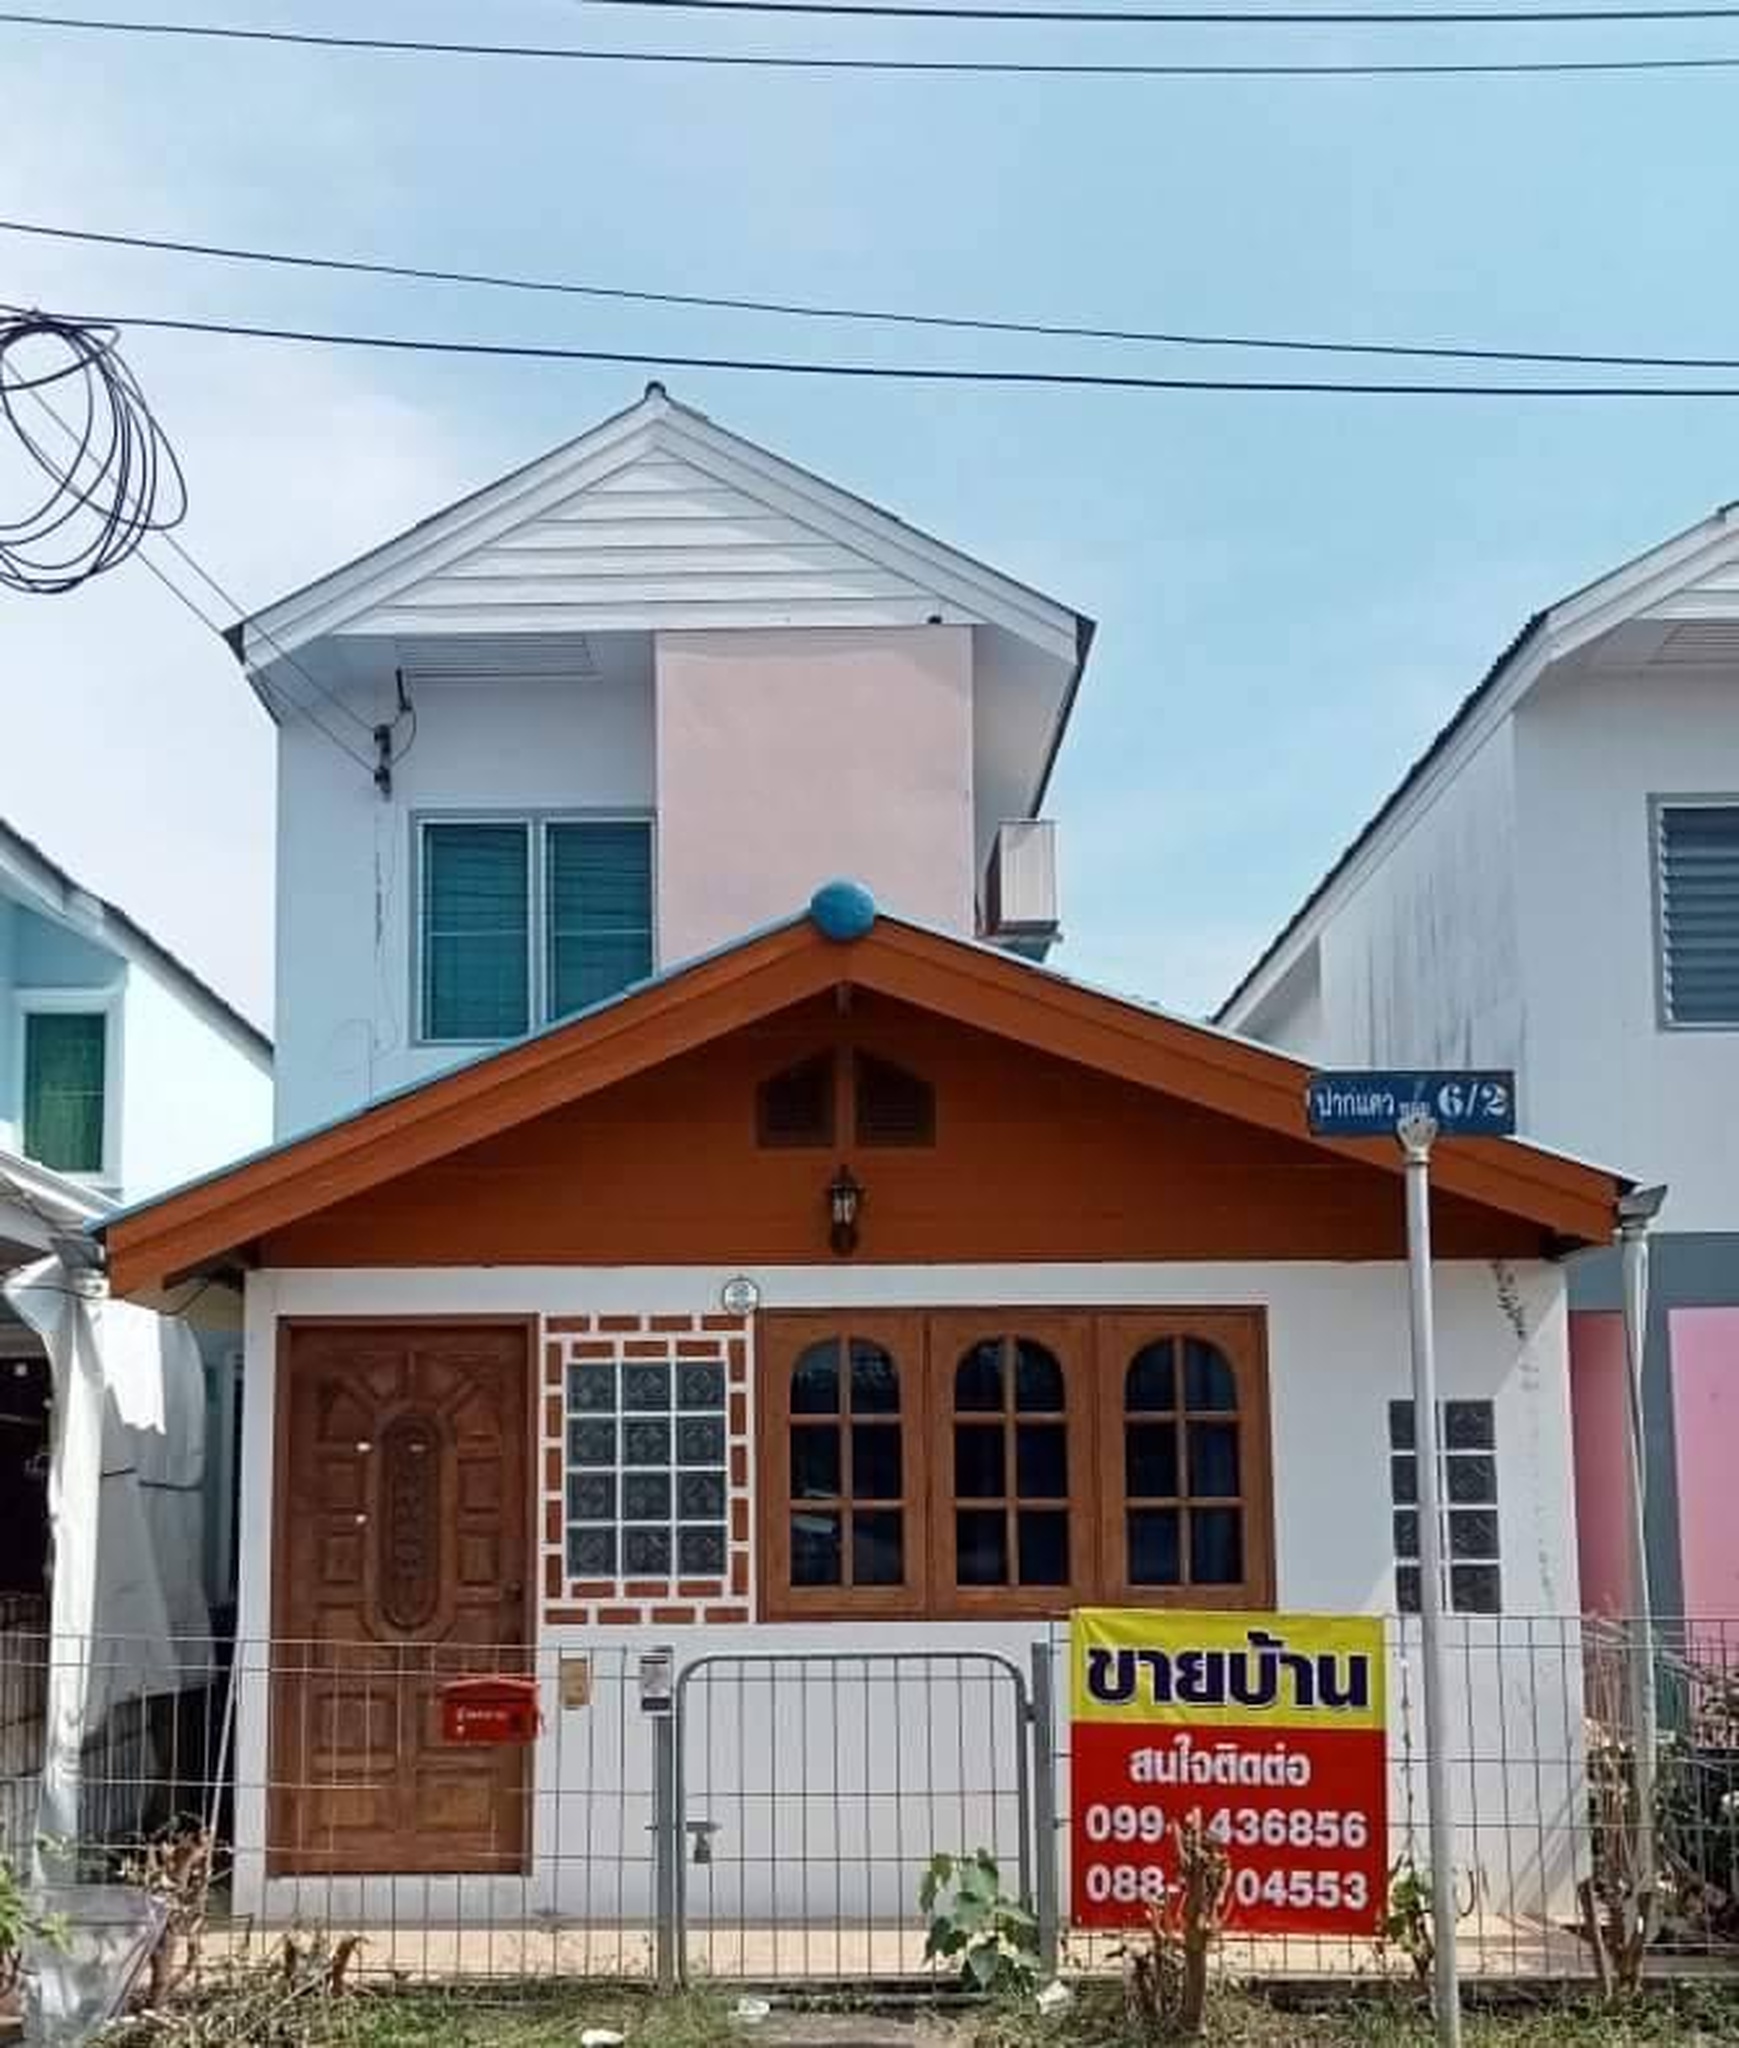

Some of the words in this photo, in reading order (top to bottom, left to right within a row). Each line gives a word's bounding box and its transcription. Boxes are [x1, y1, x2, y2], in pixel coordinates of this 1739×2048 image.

[1437, 1083, 1507, 1118] 6/2
[1087, 1630, 1370, 1708] ขายบ้าน
[1129, 1733, 1311, 1786] สนใจติดต่อ
[1086, 1865, 1368, 1910] 088-04553
